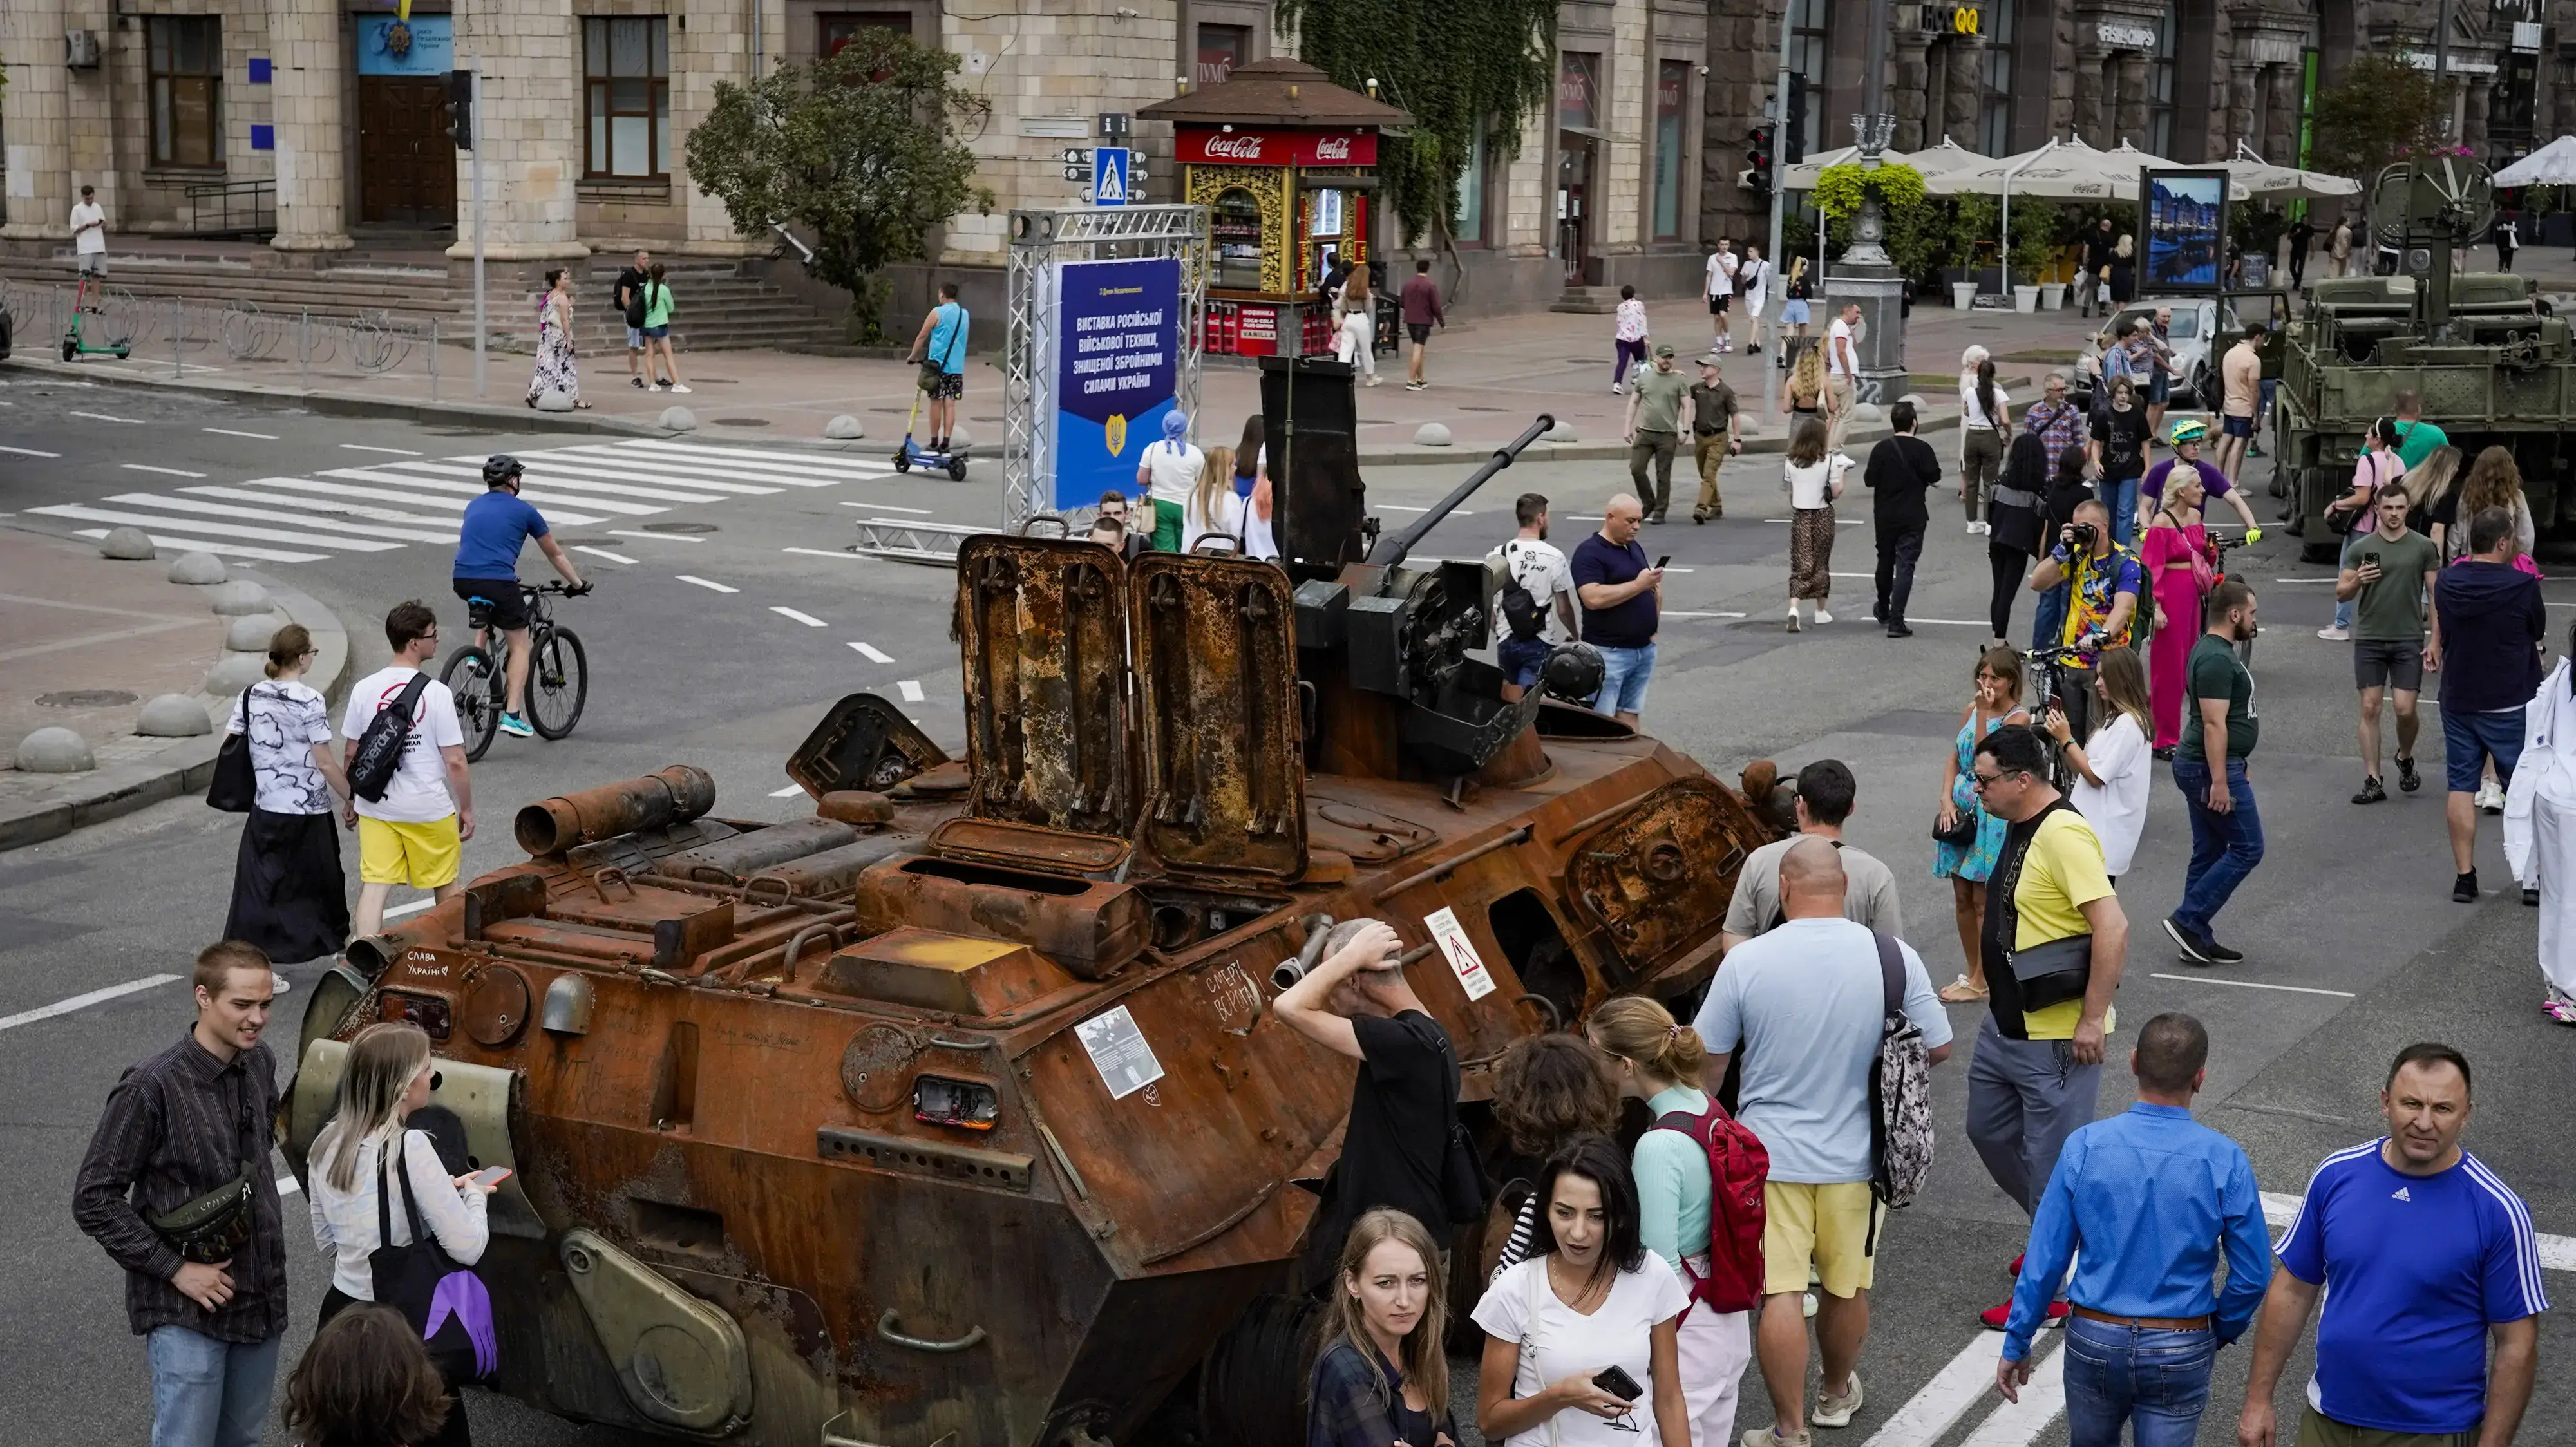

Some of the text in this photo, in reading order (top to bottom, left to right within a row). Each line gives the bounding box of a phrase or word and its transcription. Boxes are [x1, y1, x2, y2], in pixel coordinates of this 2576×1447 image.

[1204, 135, 1264, 159] Coca-Cola
[1316, 137, 1350, 160] Coca-Cola
[1077, 308, 1163, 332] ВИСТАВКА РОСІЙСЬКОЇ
[1079, 332, 1159, 352] ВІЙСЬКОВОЇ ТЕХНІКИ,
[1073, 352, 1163, 374] ЗНИЩЕНОЇ ЗБРОЙНИМИ
[1084, 372, 1151, 394] СИЛАМИ УКРАЇНИ
[407, 951, 435, 961] СЛАВА
[2391, 1194, 2411, 1202] adidas
